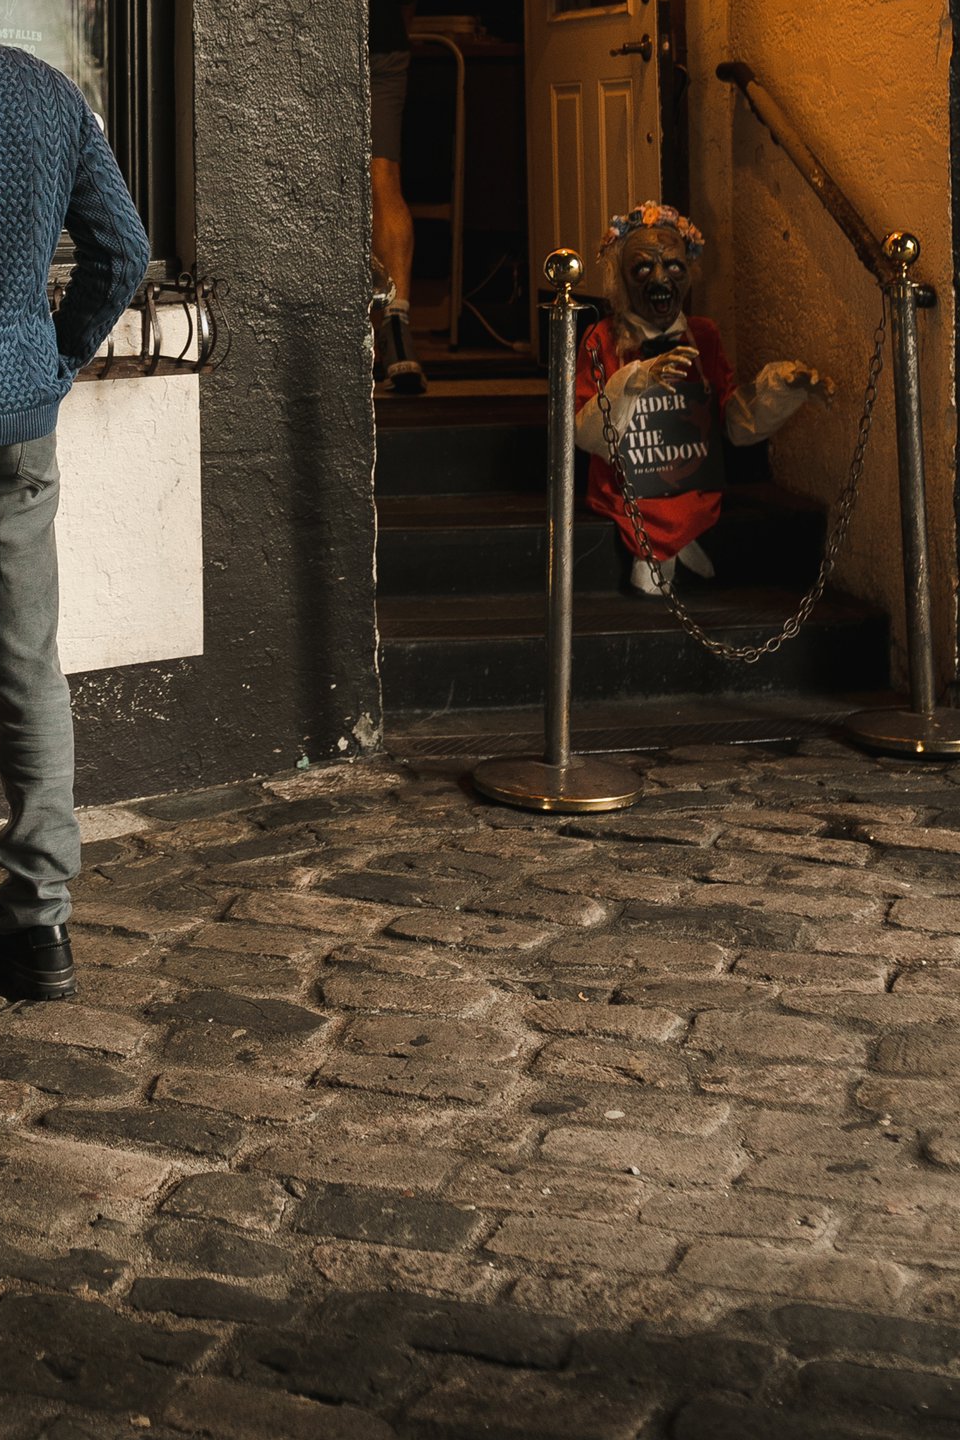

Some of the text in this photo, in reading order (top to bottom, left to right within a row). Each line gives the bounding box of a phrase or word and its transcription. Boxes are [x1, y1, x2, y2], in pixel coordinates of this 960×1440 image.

[635, 394, 687, 414] RDER
[625, 429, 664, 449] THE
[627, 441, 709, 465] WINDOW
